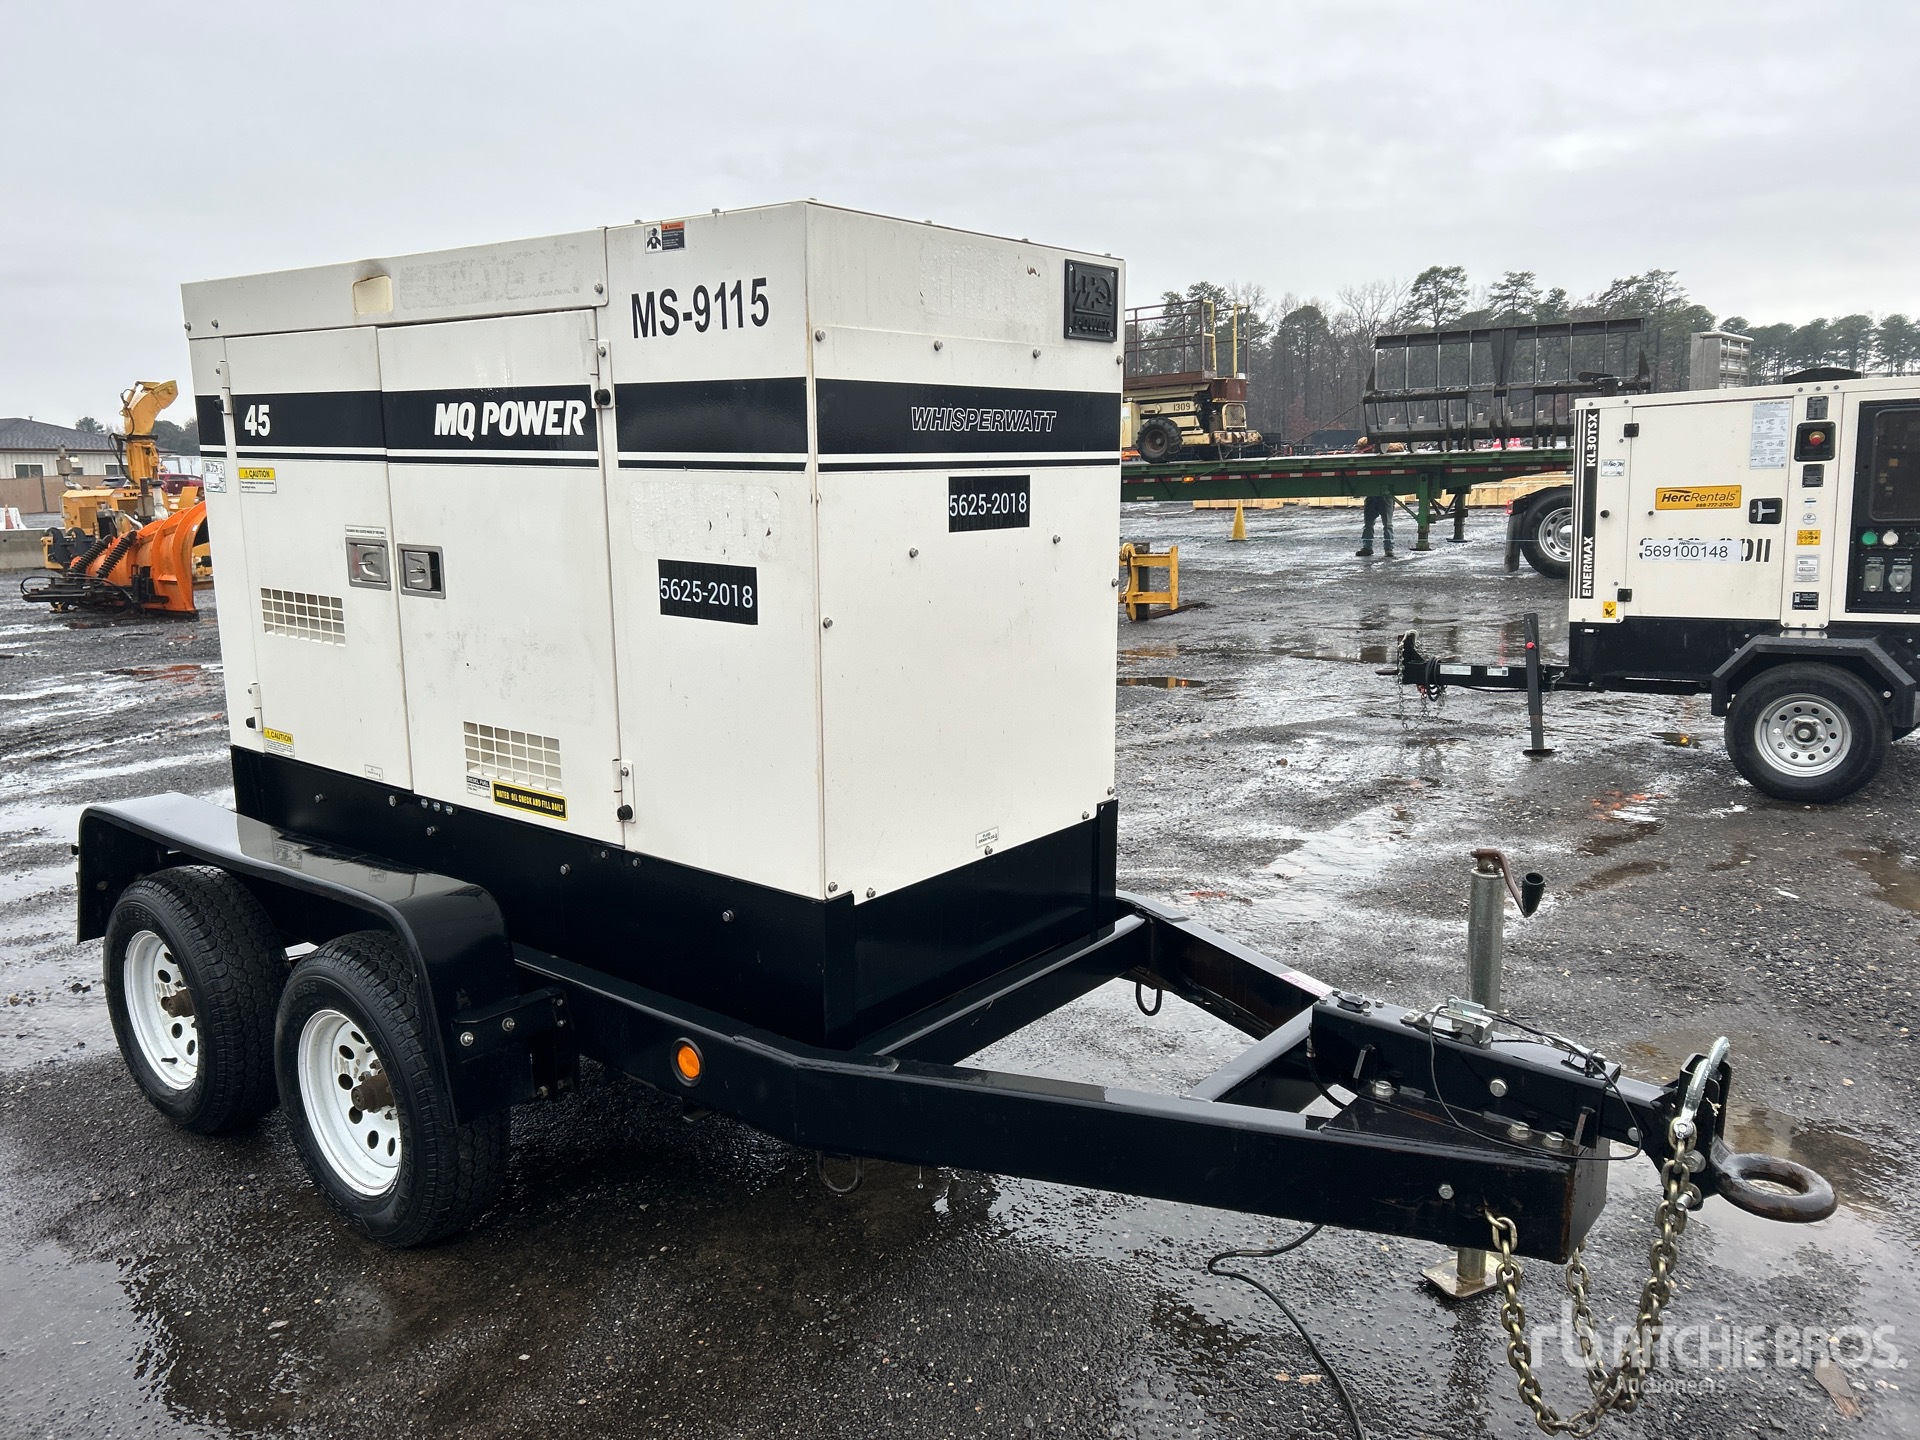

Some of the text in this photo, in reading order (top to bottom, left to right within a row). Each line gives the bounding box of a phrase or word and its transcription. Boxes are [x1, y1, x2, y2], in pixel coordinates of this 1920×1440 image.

[631, 277, 769, 338] MS-9115
[911, 406, 1057, 432] WHISPERWATT
[1173, 402, 1191, 412] 1309
[244, 404, 271, 436] 45
[434, 400, 586, 441] MQ POWER
[1586, 413, 1598, 467] KL30TSX
[249, 470, 270, 478] CAUTION
[949, 492, 1027, 517] 5625-2018
[1661, 491, 1737, 502] HercRentals
[1644, 545, 1728, 559] 569100148
[1582, 536, 1594, 597] ENERMAX
[660, 577, 753, 609] 5625-2018
[271, 731, 292, 742] CAUTION
[496, 790, 510, 799] WATER
[519, 794, 532, 805] CHECK
[533, 797, 541, 806] AND
[541, 799, 551, 809] FILL
